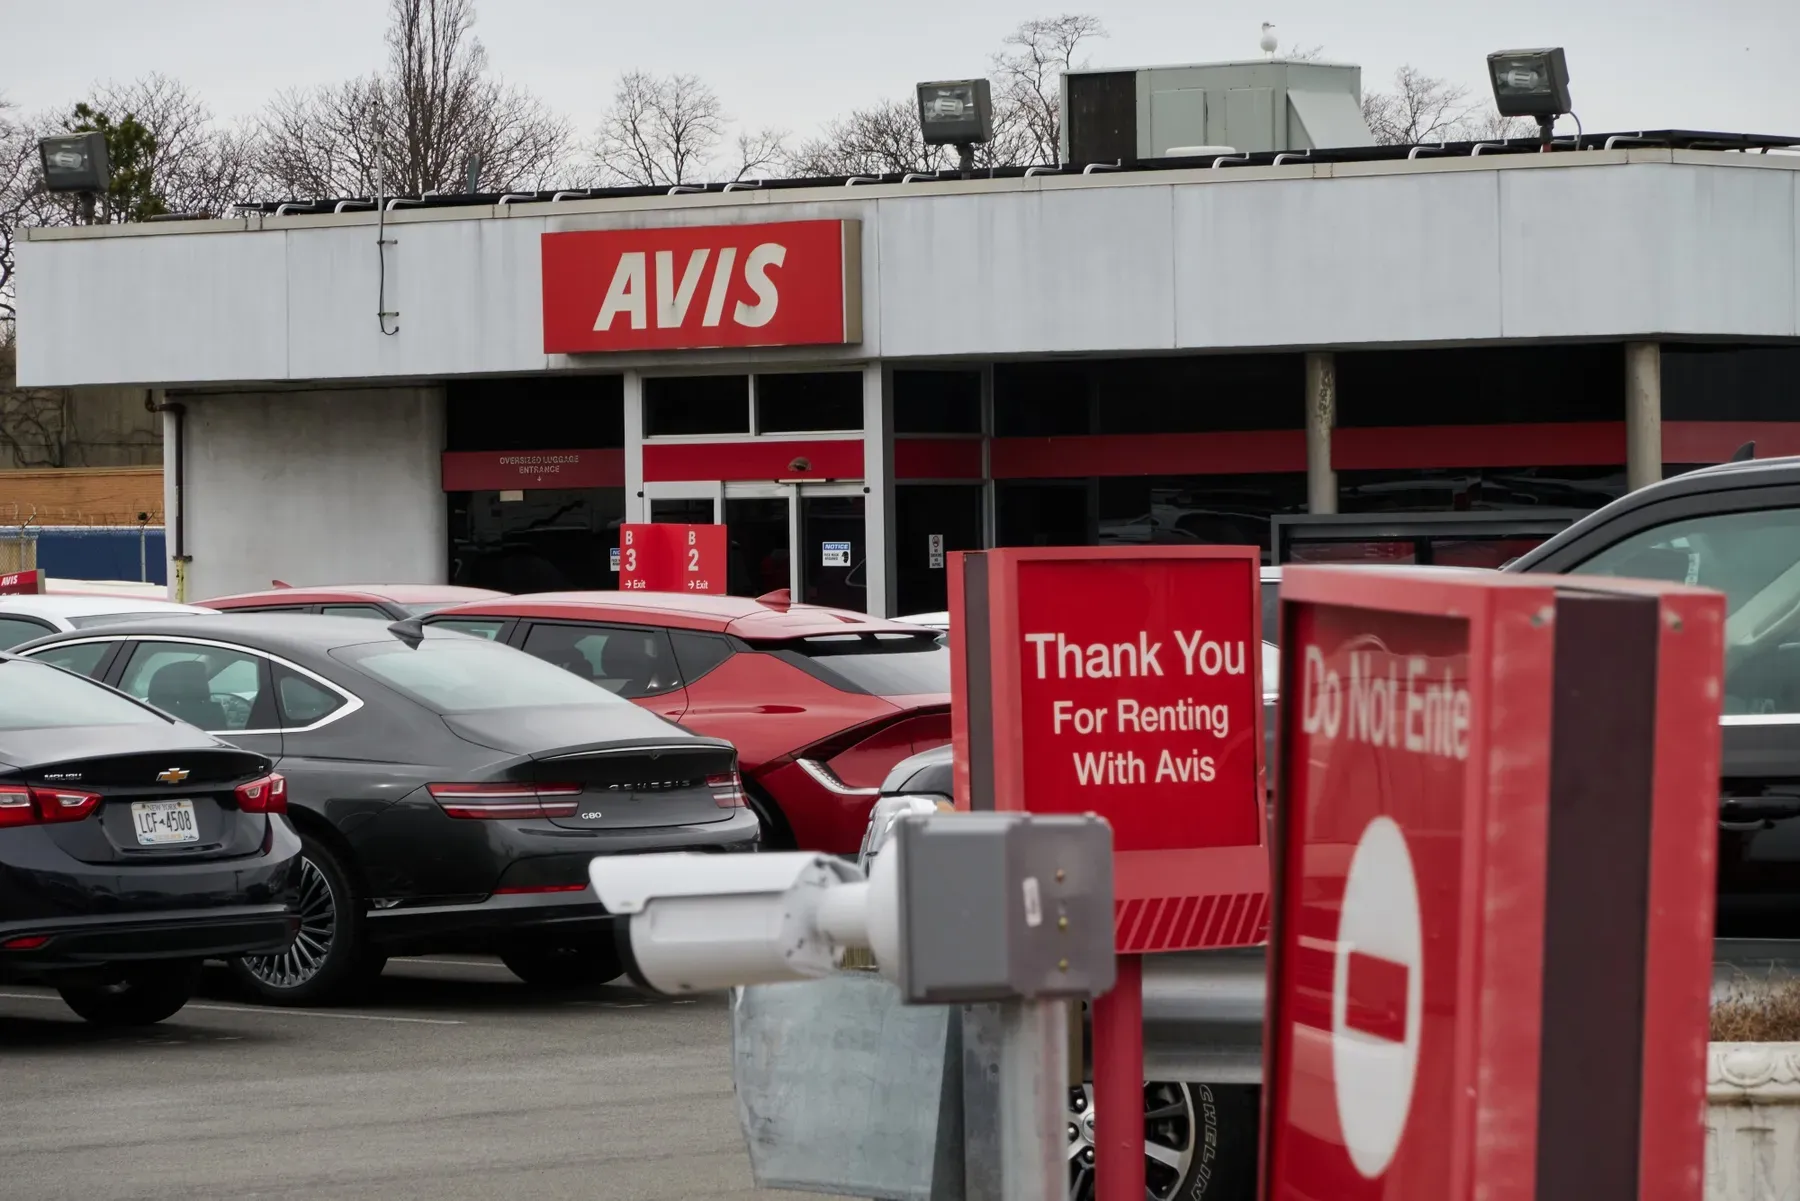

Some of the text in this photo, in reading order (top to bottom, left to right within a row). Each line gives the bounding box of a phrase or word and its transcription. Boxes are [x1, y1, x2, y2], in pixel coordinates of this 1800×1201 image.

[593, 243, 787, 331] AVIS
[500, 455, 579, 465] OVERSIZED LUGGAGE
[519, 465, 560, 474] ENTRANCE
[625, 530, 634, 545] B
[688, 530, 697, 545] B
[625, 548, 637, 572] 3
[687, 548, 699, 572] 2
[1, 575, 18, 586] AVIS
[633, 579, 646, 589] Exit
[696, 580, 708, 589] Exit
[1025, 630, 1245, 679] Thank You
[1303, 645, 1470, 761] Do Not Ente
[1053, 698, 1230, 739] For Renting
[1073, 749, 1216, 786] With Avis
[581, 811, 602, 820] G80
[1190, 1084, 1217, 1201] CHELIN
